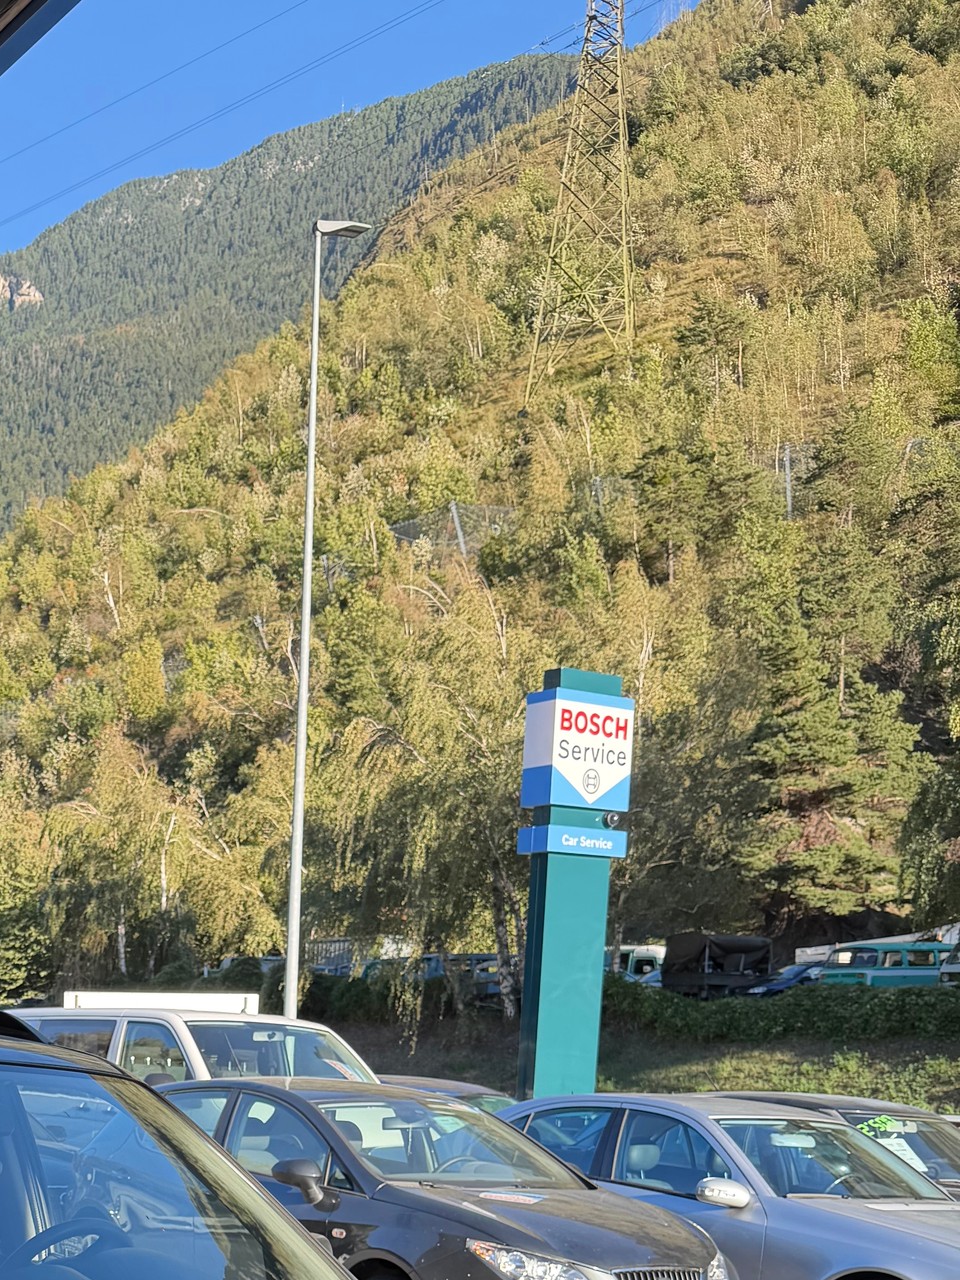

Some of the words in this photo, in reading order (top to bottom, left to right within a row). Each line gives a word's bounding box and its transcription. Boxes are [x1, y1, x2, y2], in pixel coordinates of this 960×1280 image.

[560, 708, 628, 740] BOSCH
[558, 739, 626, 767] Service
[561, 834, 578, 847] Car
[580, 835, 613, 850] Service
